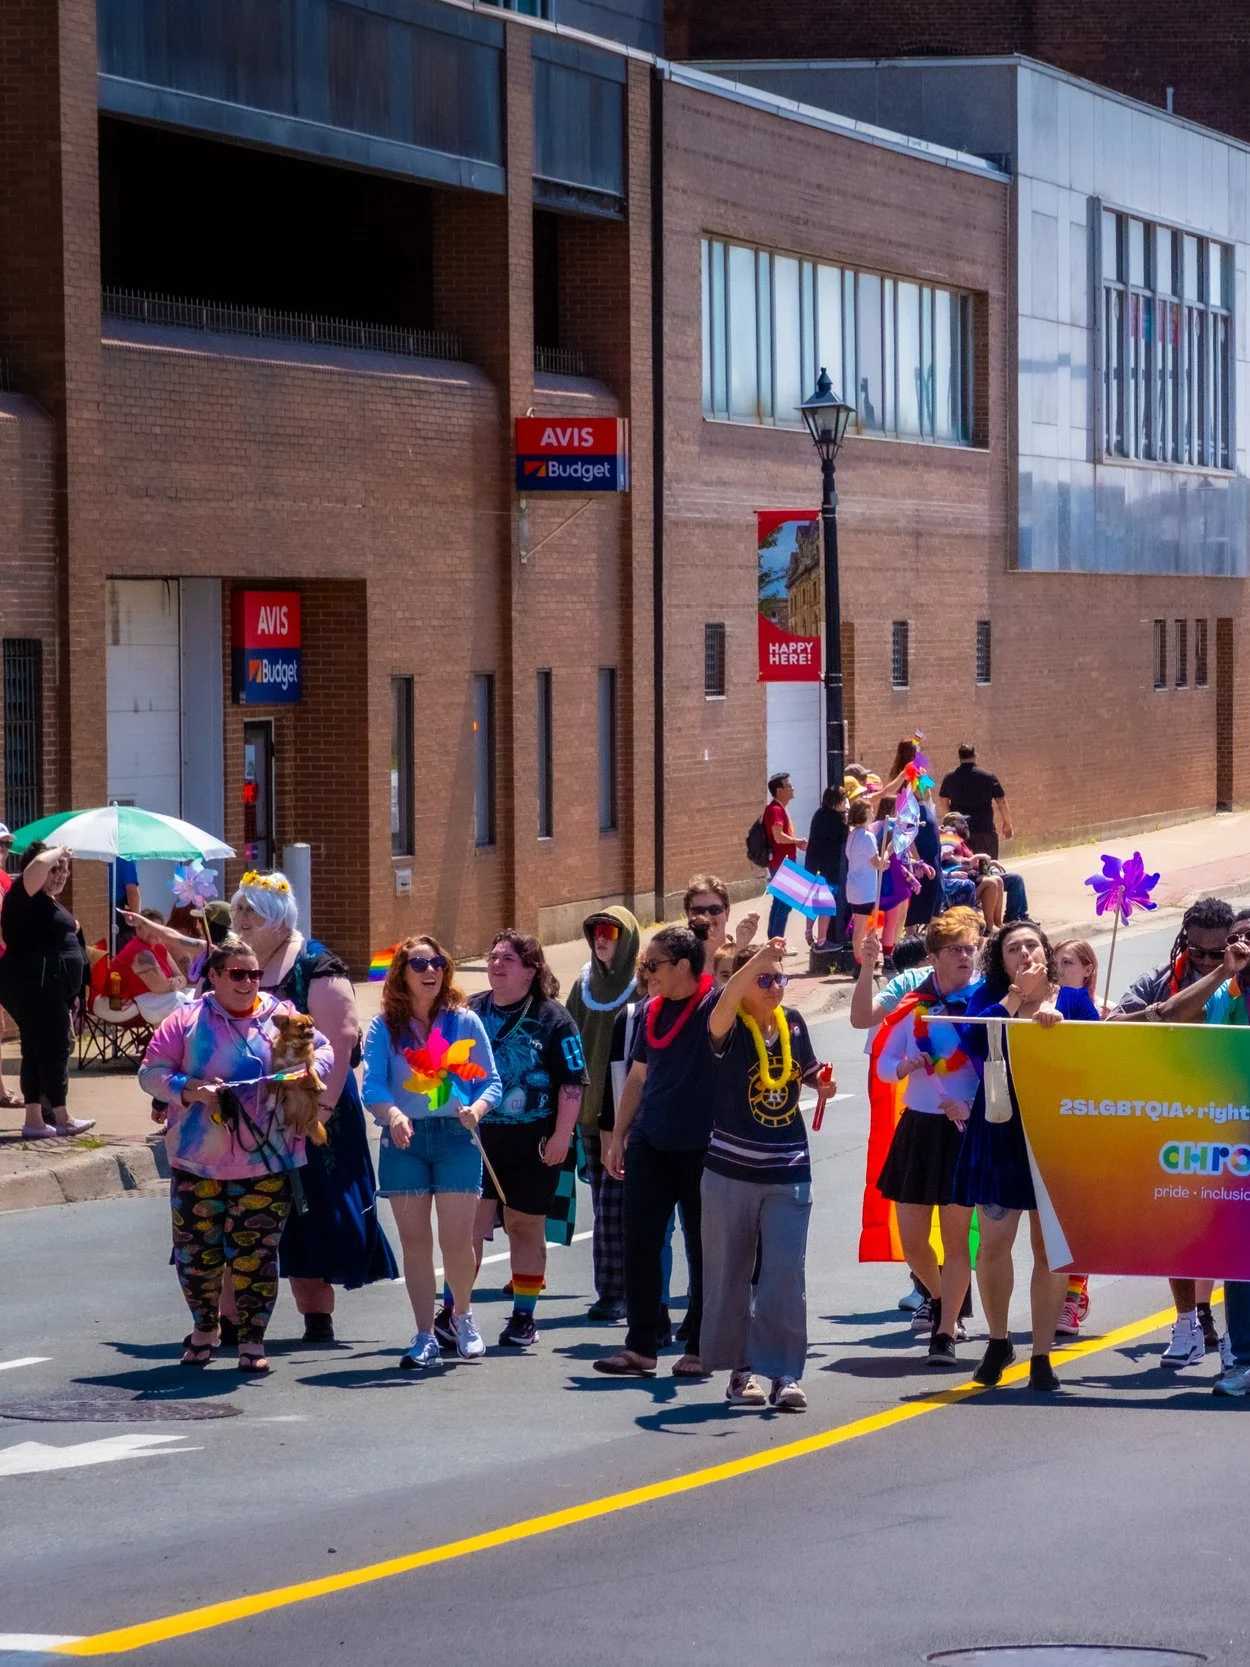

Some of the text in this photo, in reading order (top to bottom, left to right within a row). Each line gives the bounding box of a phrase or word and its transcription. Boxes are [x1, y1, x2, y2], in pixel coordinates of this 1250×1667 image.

[540, 427, 594, 447] AVIS
[548, 460, 610, 482] Budget
[257, 605, 288, 635] AVIS
[769, 642, 813, 653] HAPPY
[769, 653, 812, 665] HERE!
[262, 659, 297, 691] Budget
[1059, 1098, 1194, 1122] 2SLGBTQIA+
[1154, 1185, 1189, 1200] pride
